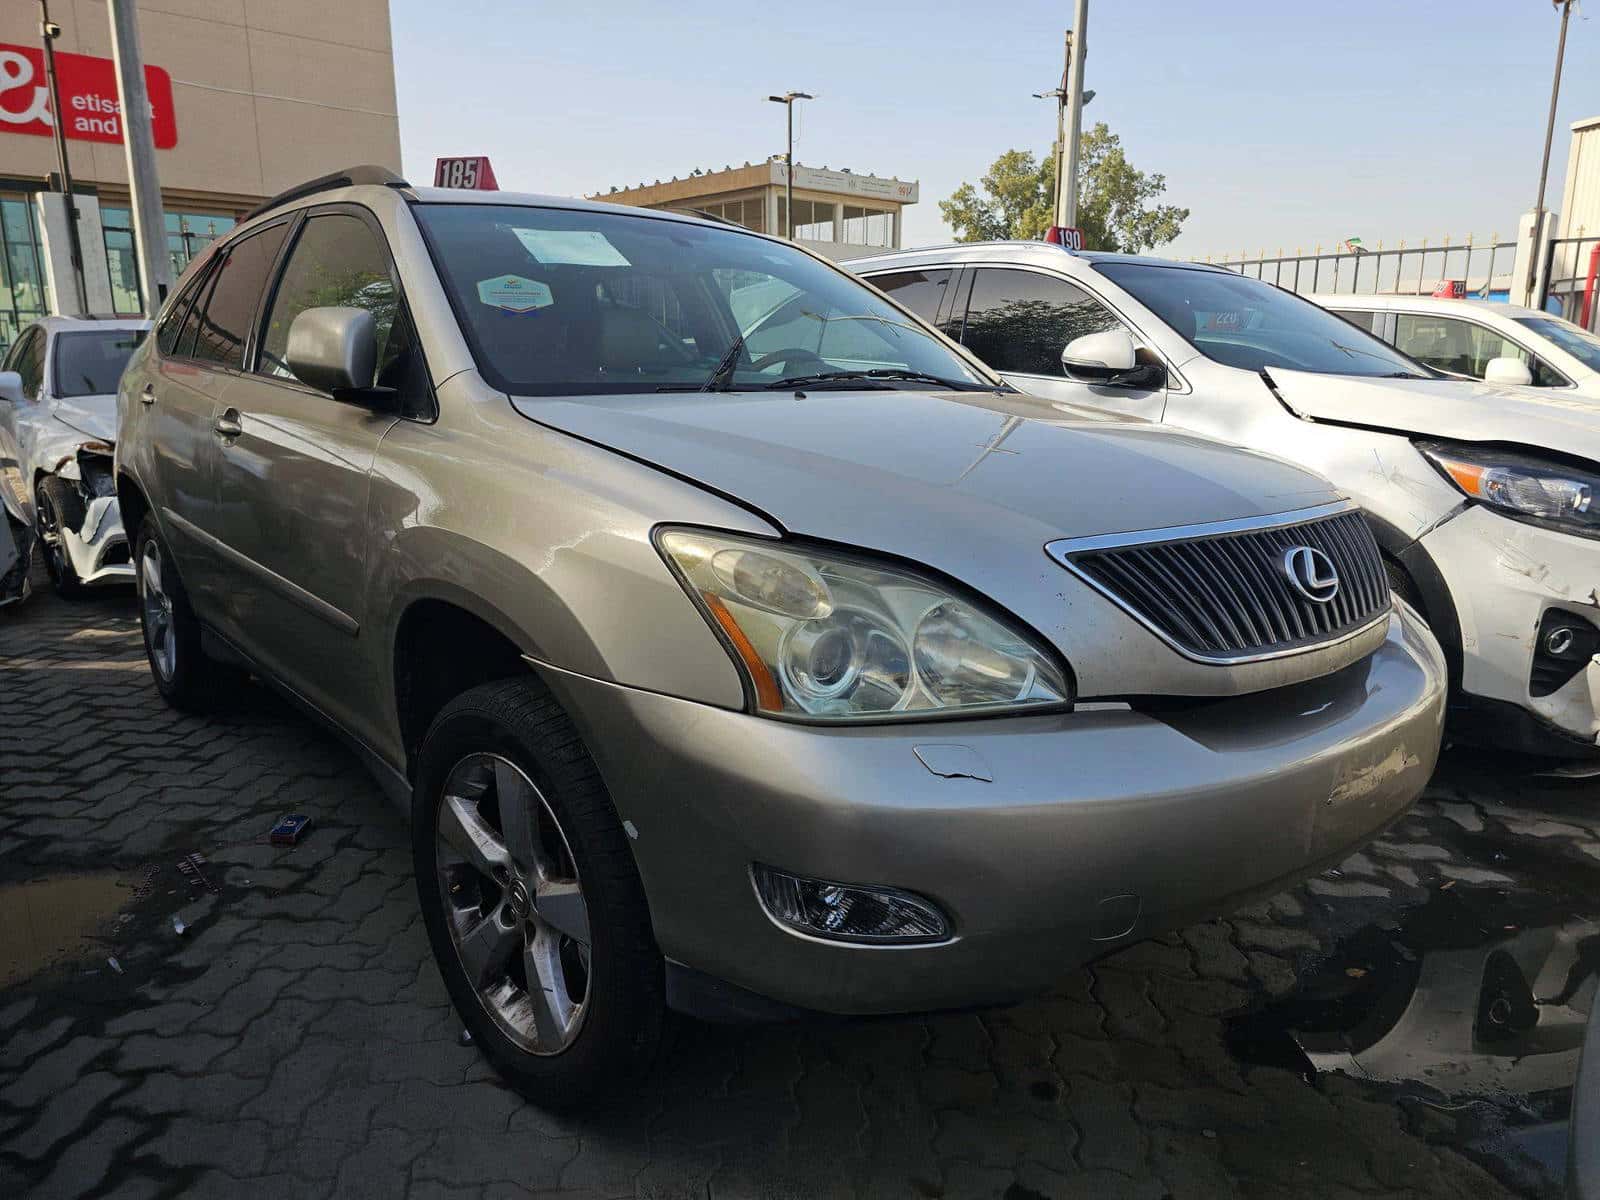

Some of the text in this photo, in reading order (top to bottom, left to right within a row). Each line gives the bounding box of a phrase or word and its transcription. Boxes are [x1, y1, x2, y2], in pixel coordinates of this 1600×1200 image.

[75, 116, 118, 135] and
[442, 160, 477, 188] 185
[1060, 229, 1081, 250] 190
